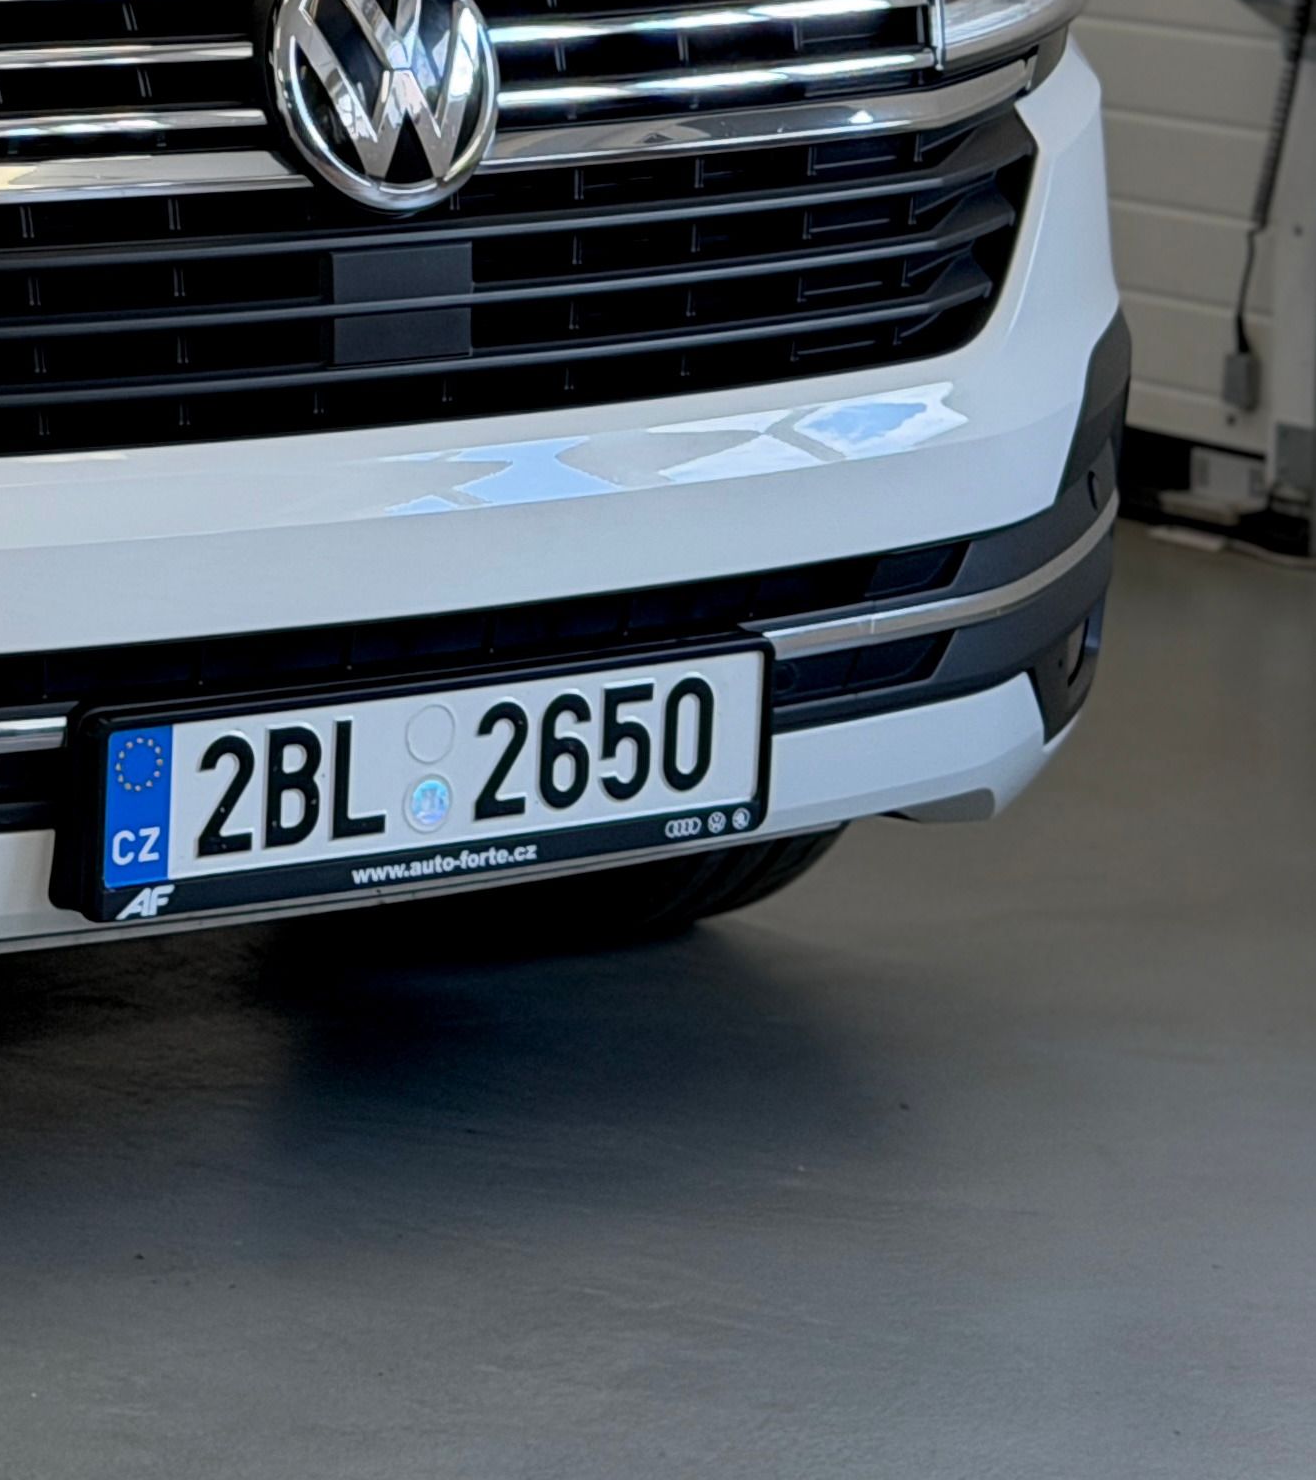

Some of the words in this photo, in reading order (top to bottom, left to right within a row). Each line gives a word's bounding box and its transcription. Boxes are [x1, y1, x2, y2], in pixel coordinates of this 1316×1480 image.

[195, 718, 387, 859] 2BL
[473, 673, 716, 822] 2650
[111, 826, 161, 866] CZ
[351, 844, 538, 885] www.auto-forte.cz
[114, 884, 176, 921] AF
